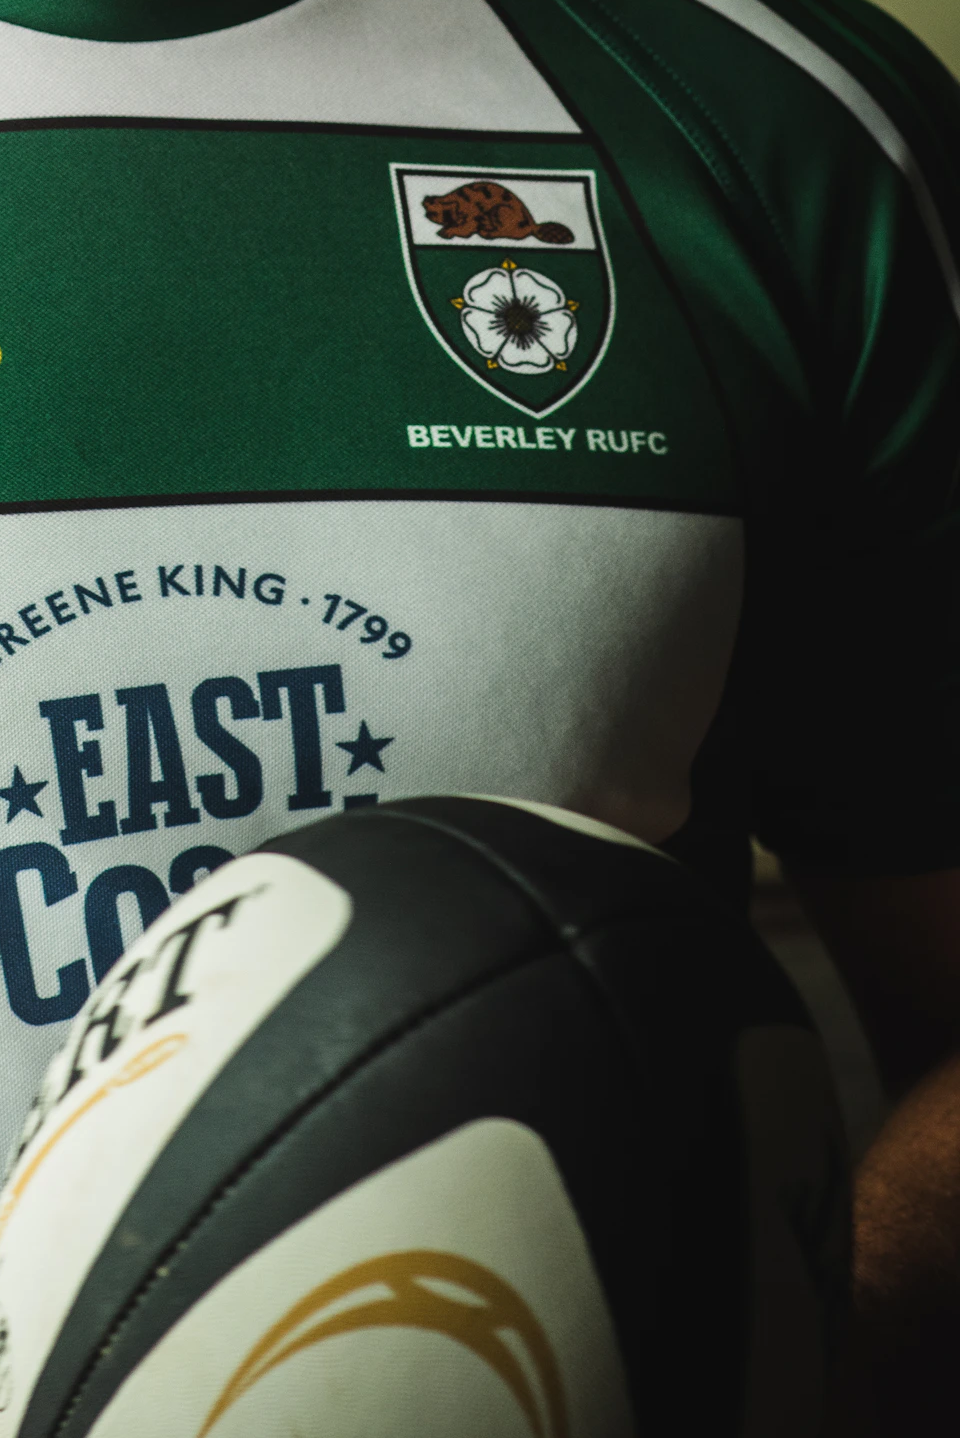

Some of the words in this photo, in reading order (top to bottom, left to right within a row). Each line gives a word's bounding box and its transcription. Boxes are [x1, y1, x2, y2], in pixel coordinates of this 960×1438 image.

[407, 425, 576, 450] BEVERLEY
[586, 429, 669, 455] RUFC
[158, 564, 287, 606] KING
[321, 593, 413, 660] 1799
[39, 663, 347, 846] EAST
